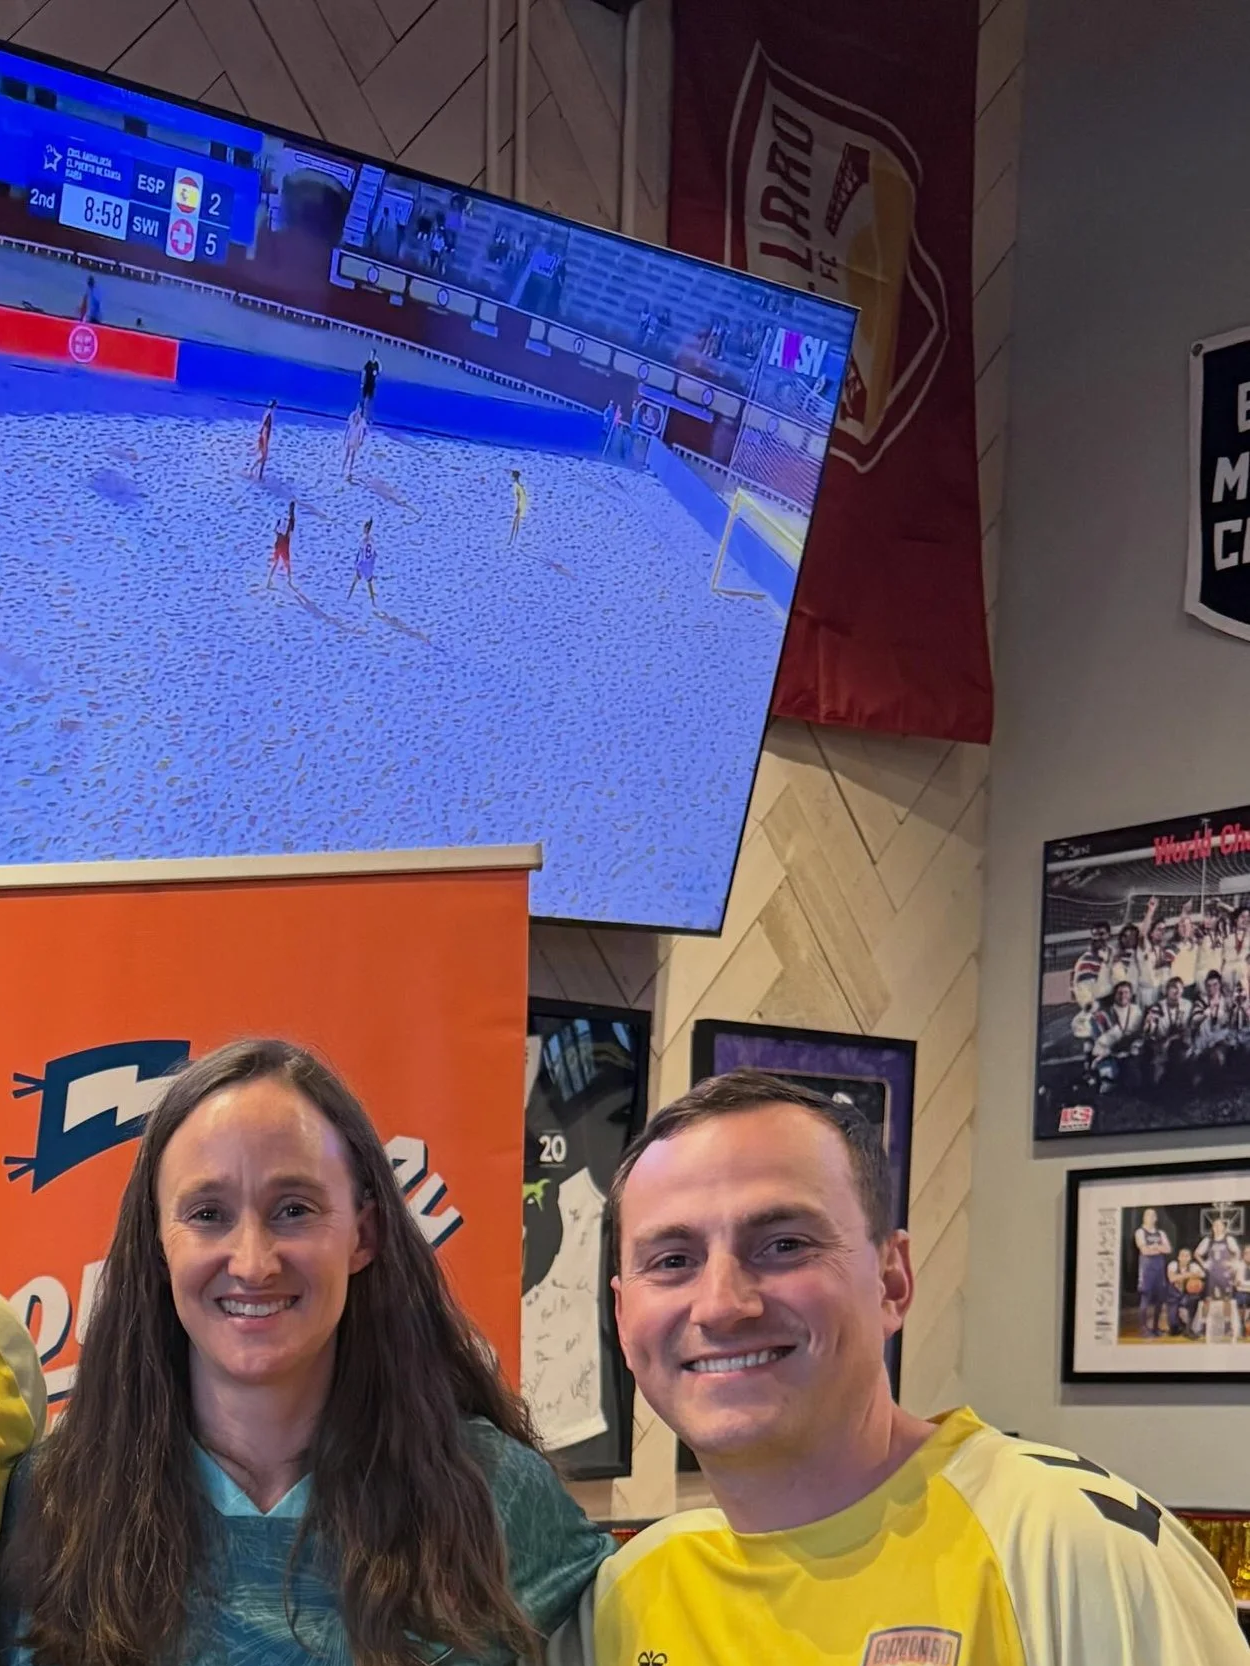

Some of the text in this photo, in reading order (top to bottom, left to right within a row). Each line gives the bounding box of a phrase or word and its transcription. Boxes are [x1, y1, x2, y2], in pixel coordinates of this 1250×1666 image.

[29, 188, 123, 230] 2nd 8:58
[137, 173, 221, 216] ESP 2
[132, 215, 218, 256] SWI 5
[1153, 827, 1213, 867] World
[538, 1134, 567, 1163] 20
